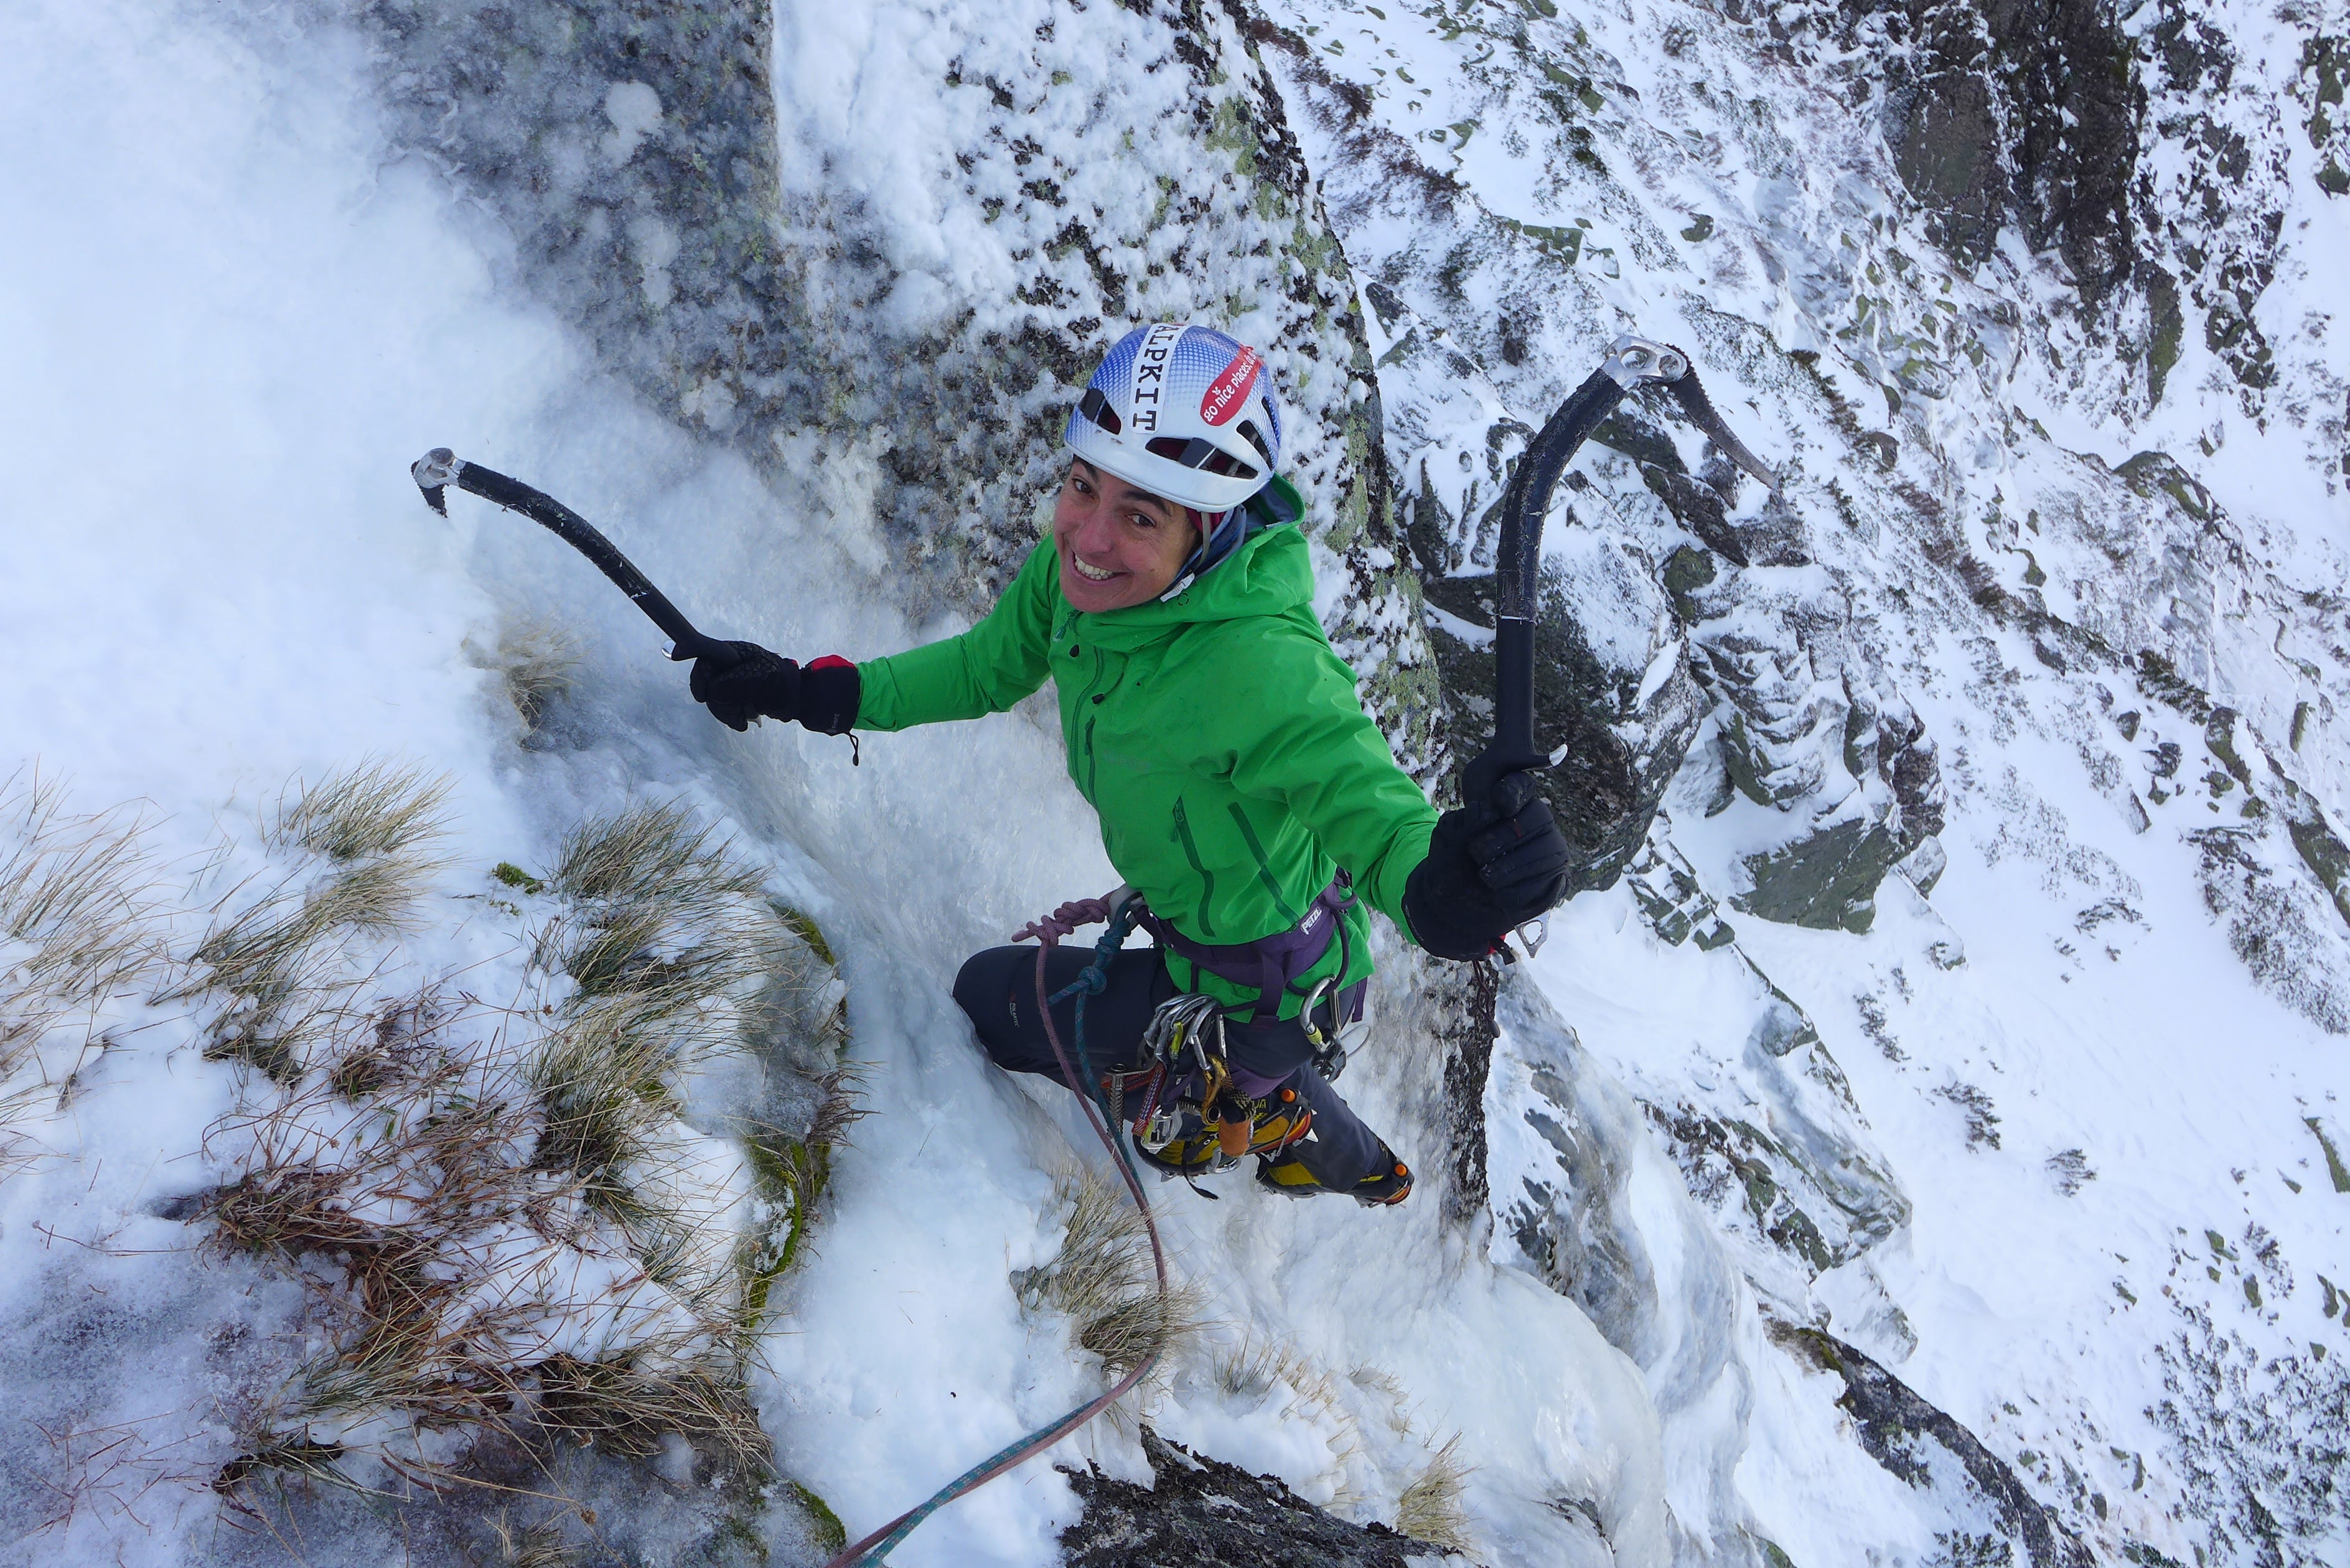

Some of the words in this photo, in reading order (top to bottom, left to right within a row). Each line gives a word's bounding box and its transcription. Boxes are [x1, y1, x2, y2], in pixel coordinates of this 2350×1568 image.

[1133, 325, 1179, 431] ALPKIT
[1204, 405, 1219, 422] go
[1214, 385, 1235, 408] nice
[1301, 908, 1322, 935] PETZL
